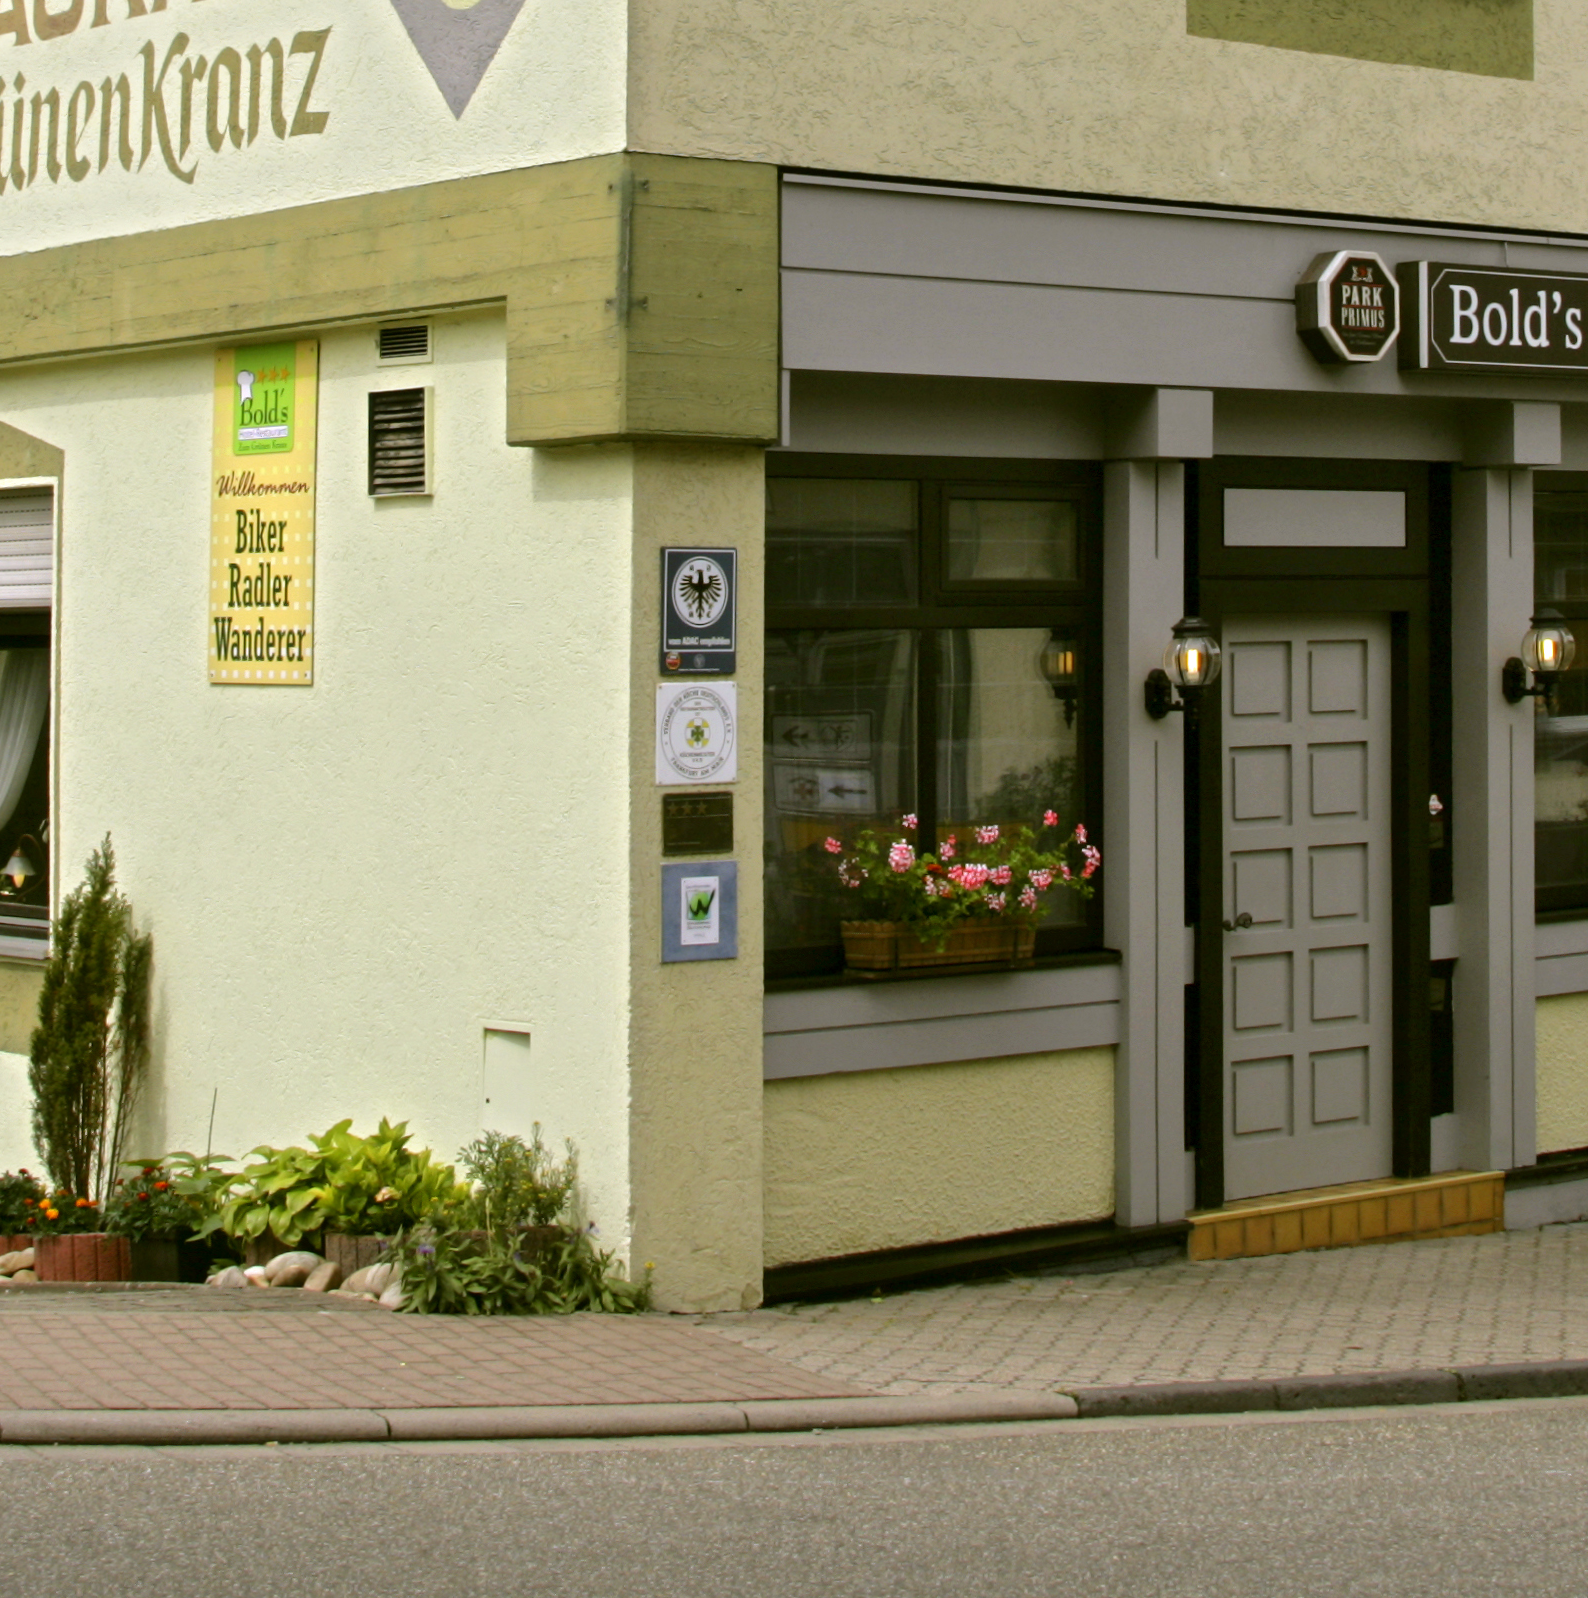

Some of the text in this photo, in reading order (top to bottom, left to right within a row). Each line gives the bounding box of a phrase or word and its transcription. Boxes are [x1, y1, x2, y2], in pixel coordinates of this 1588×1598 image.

[136, 24, 334, 186] Kranz
[1341, 284, 1383, 307] PARK
[1341, 307, 1385, 329] PRIMUS
[1448, 283, 1583, 351] Bold's
[239, 387, 289, 426] Bold's
[216, 470, 310, 498] Willkommen
[235, 508, 288, 554] Biker
[228, 562, 292, 608] Radler
[213, 616, 307, 663] Wanderer
